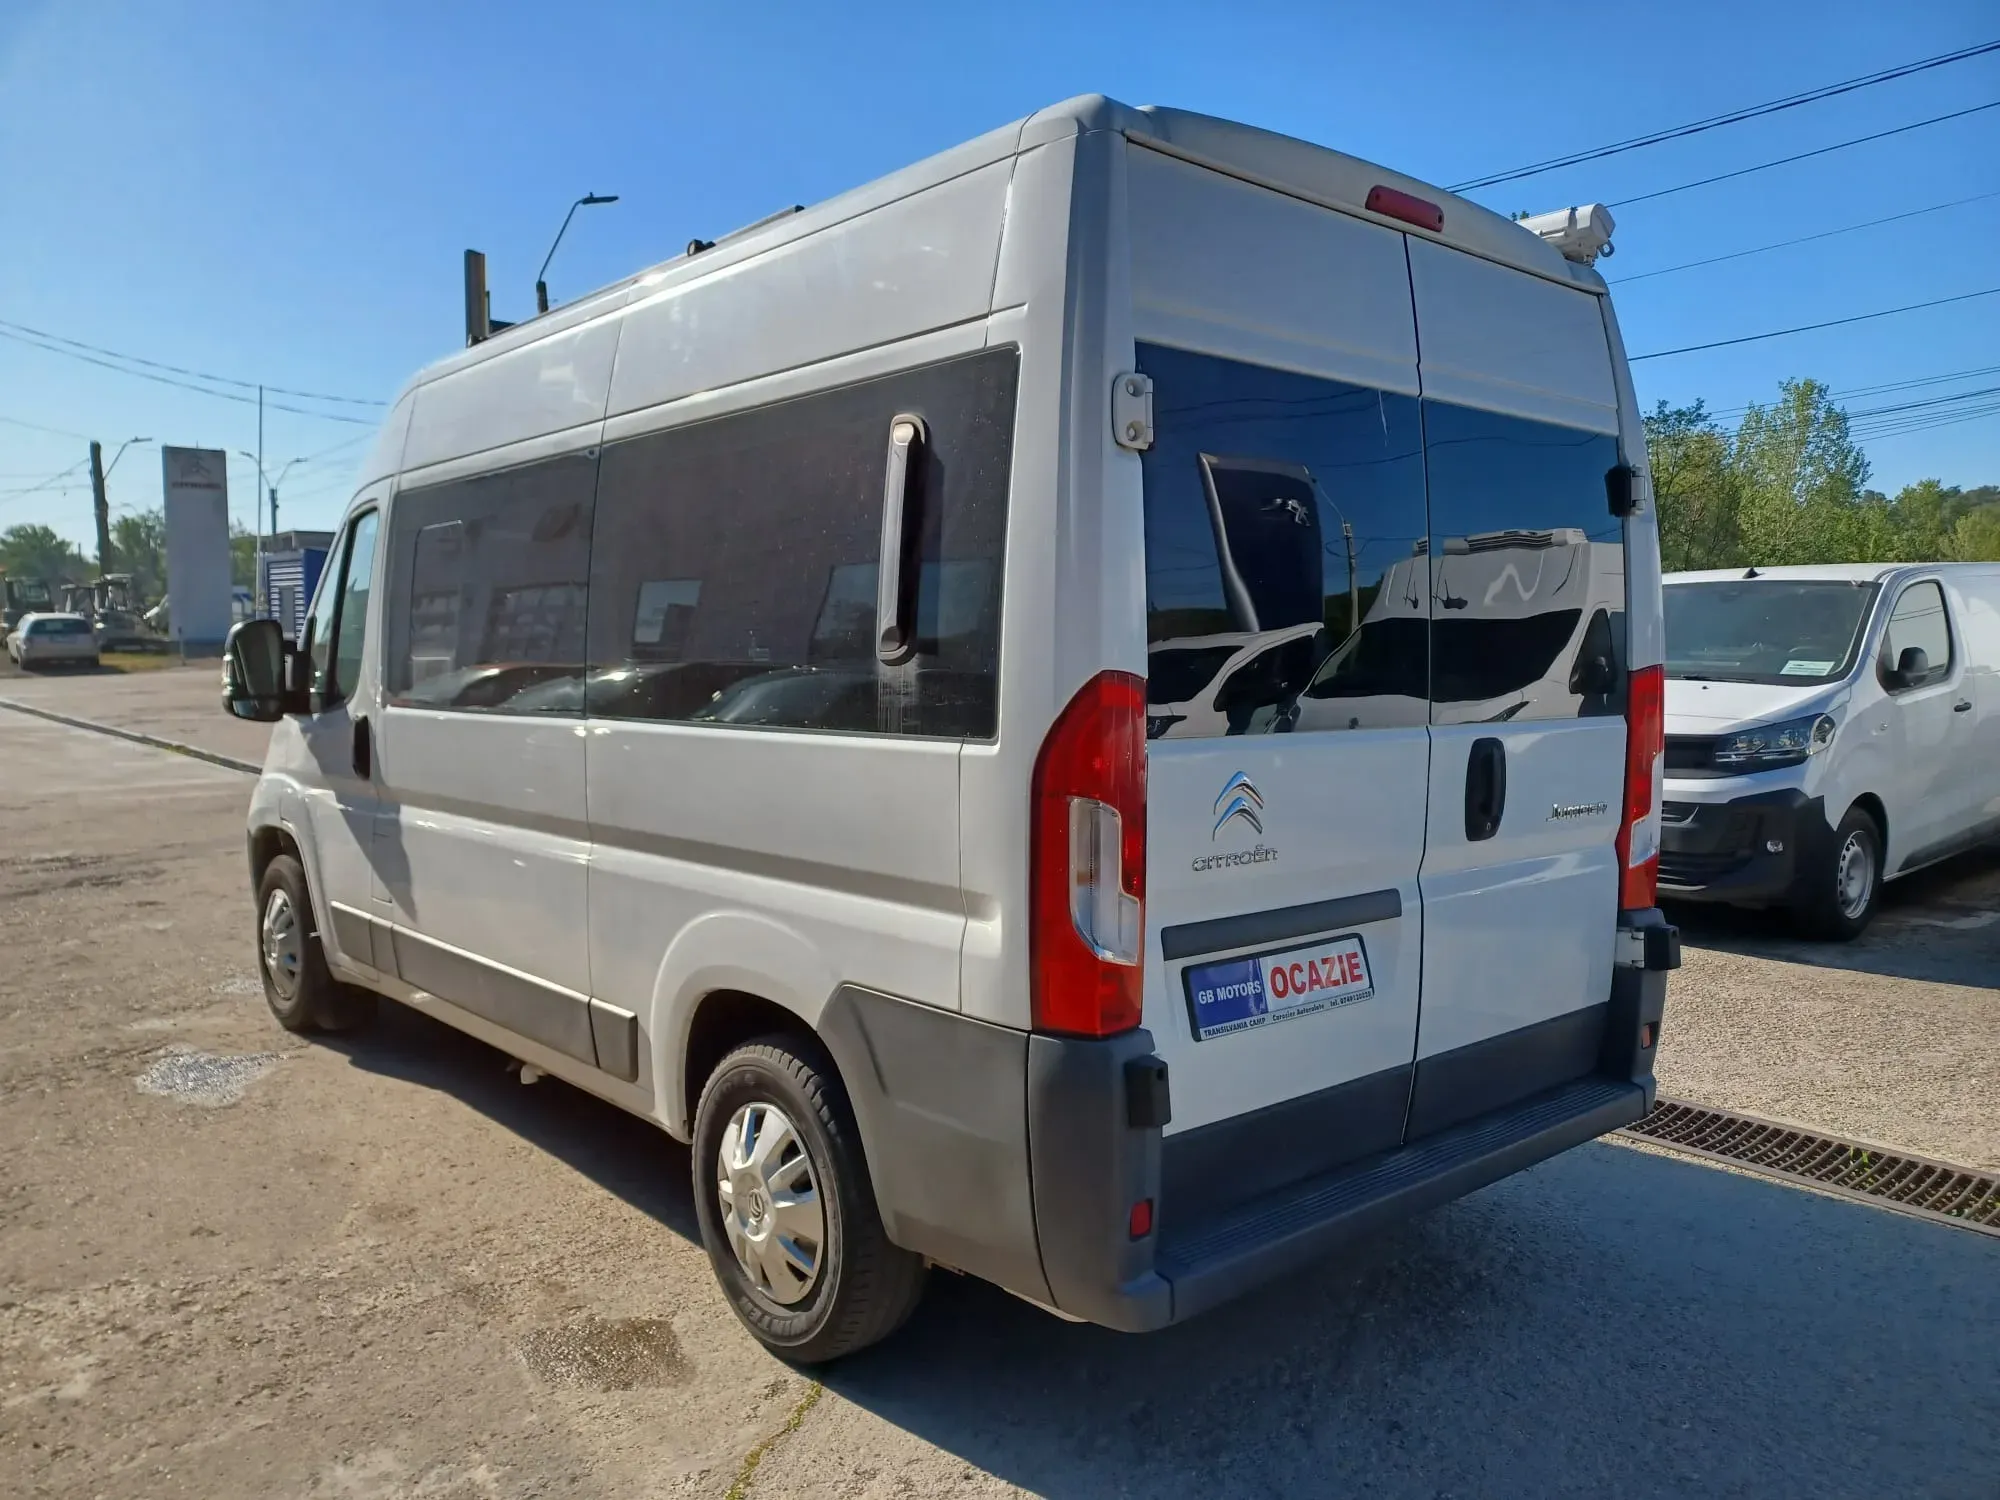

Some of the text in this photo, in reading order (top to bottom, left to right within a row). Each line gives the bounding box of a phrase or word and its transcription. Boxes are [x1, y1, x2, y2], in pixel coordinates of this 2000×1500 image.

[1269, 951, 1364, 999] OCAZIE
[1198, 980, 1262, 1005] GB MOTORS
[1204, 1021, 1249, 1038] TRANSILVANIA
[1249, 1017, 1266, 1027] CAMP
